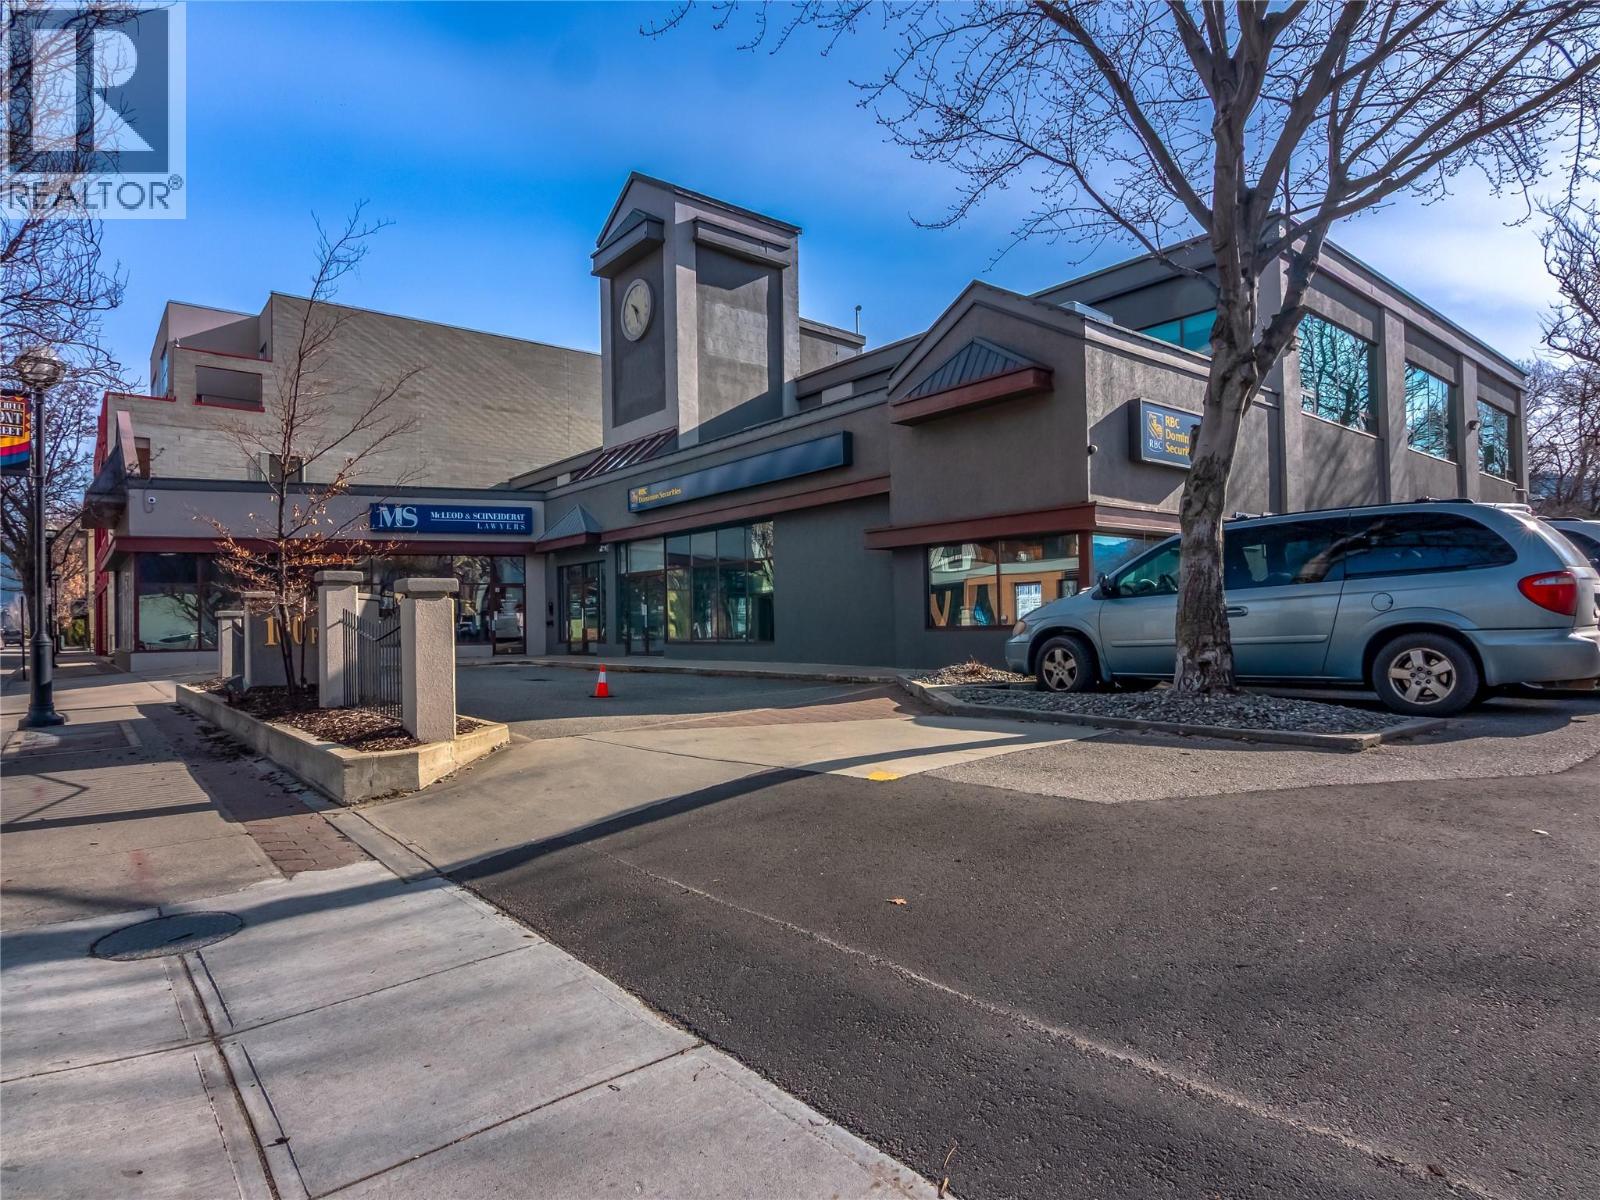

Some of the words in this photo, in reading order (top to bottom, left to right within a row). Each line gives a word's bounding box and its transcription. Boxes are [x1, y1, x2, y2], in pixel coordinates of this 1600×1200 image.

[1165, 415, 1180, 429] RBC
[0, 427, 22, 436] EET
[1149, 439, 1162, 450] RBC
[477, 522, 526, 530] LAWYERS
[264, 614, 307, 646] 10
